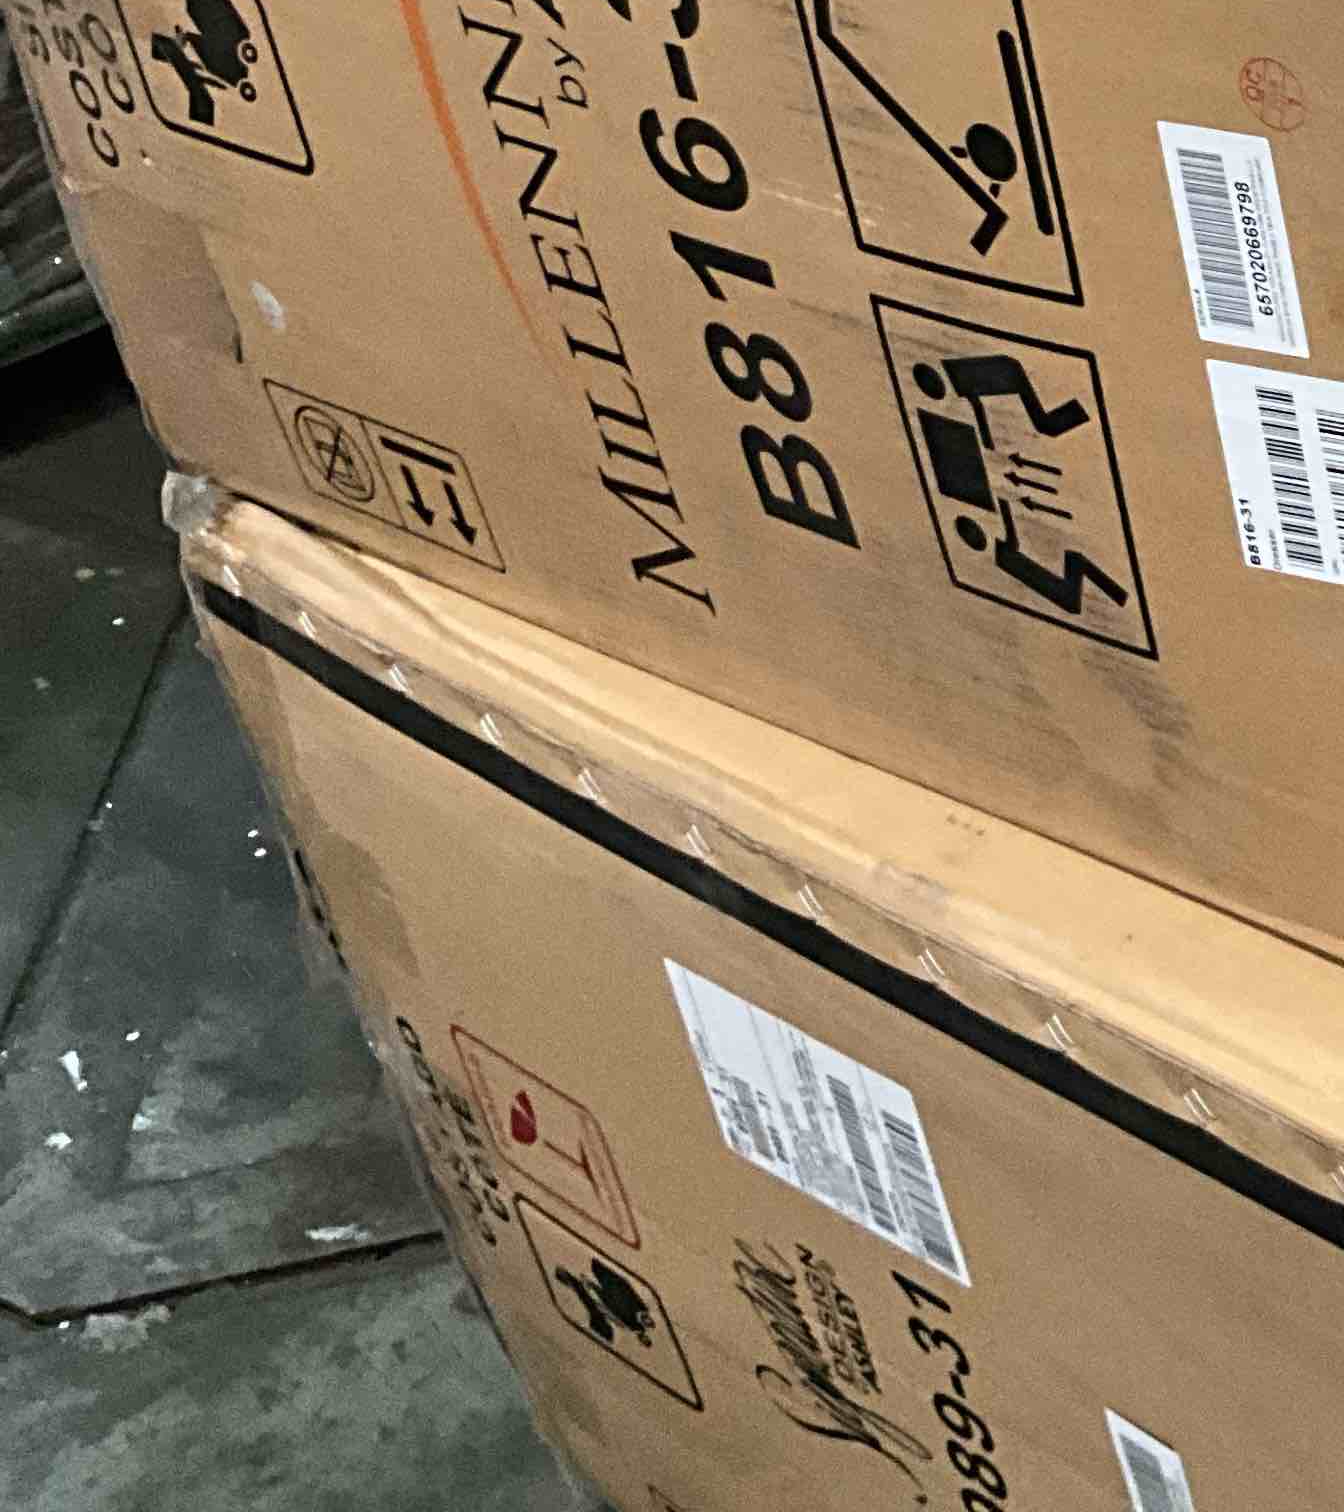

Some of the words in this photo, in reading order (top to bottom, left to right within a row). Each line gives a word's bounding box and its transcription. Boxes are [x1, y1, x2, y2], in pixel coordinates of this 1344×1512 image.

[545, 36, 590, 110] by
[1233, 181, 1275, 318] 657020669798
[1237, 496, 1262, 567] B816-31
[890, 1268, 1008, 1512] 89-31
